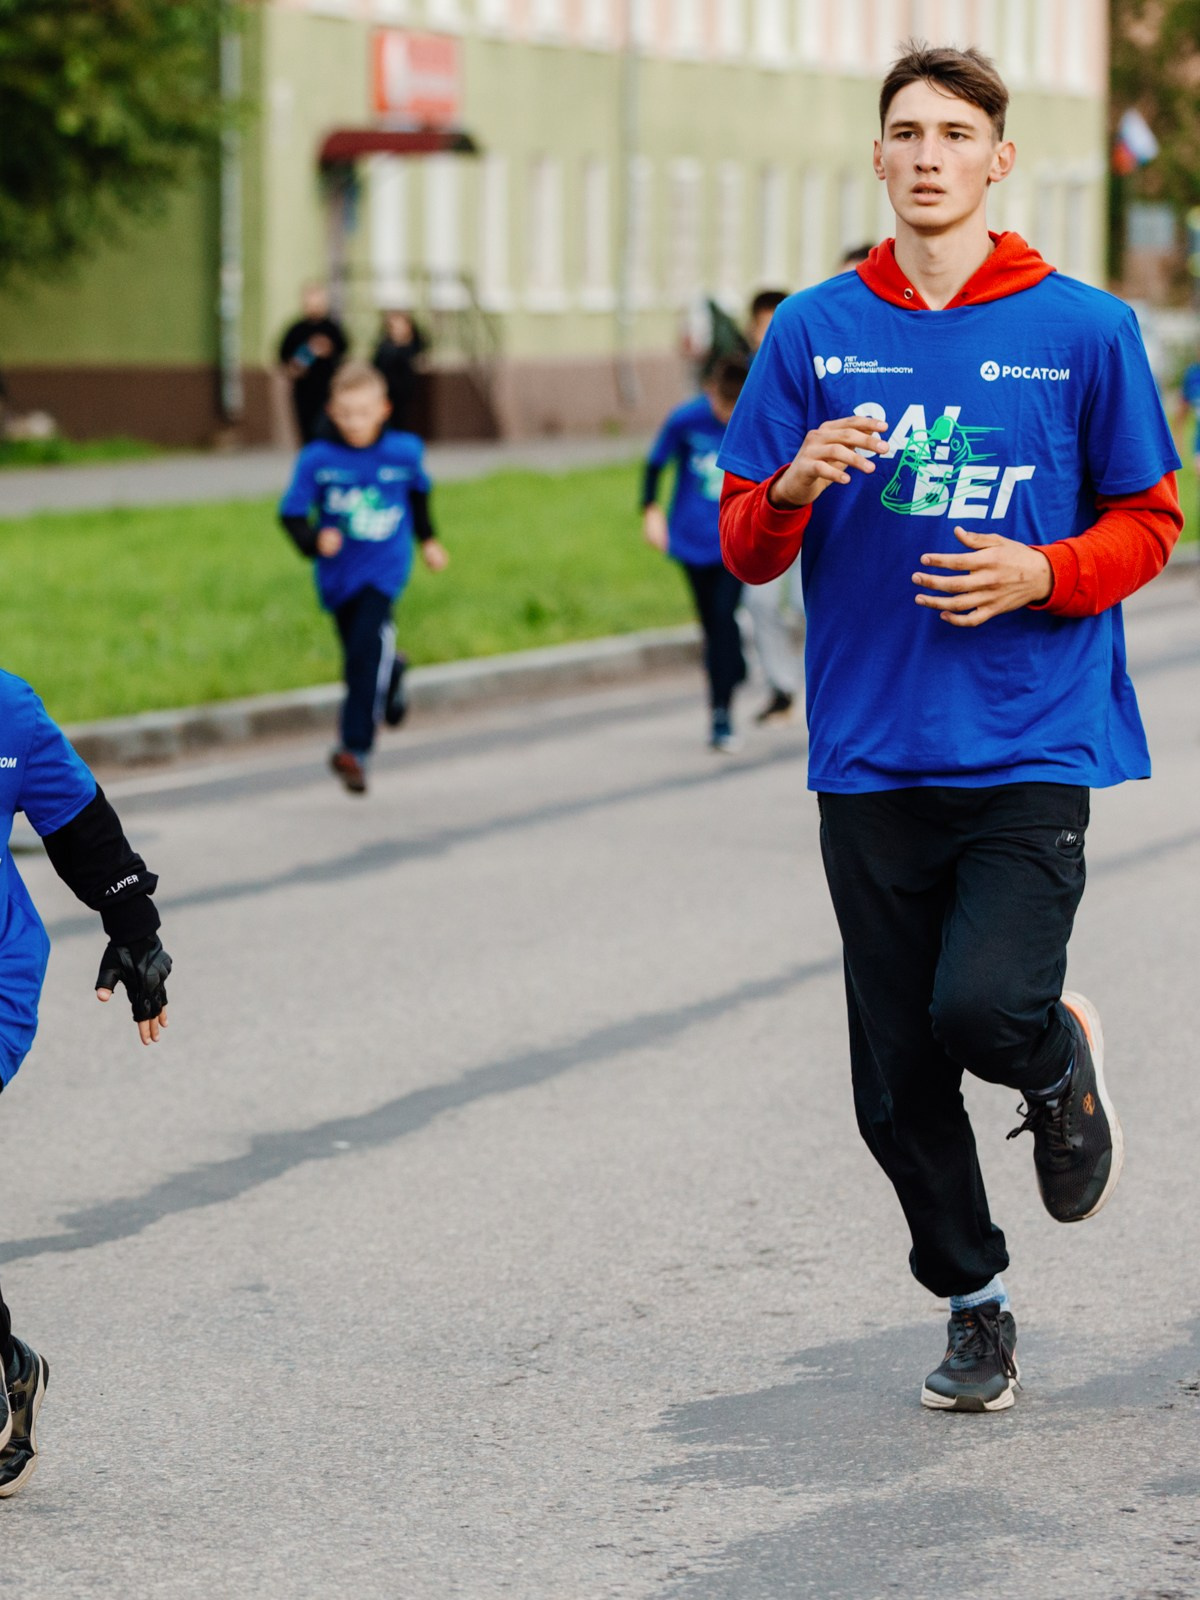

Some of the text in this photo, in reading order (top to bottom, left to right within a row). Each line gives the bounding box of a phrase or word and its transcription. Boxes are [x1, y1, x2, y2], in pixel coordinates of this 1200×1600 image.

[843, 360, 878, 368] АТОМНОЙ
[1002, 365, 1070, 381] РОСАТОМ
[910, 464, 1036, 519] БЕГ
[110, 874, 139, 893] LAYER
